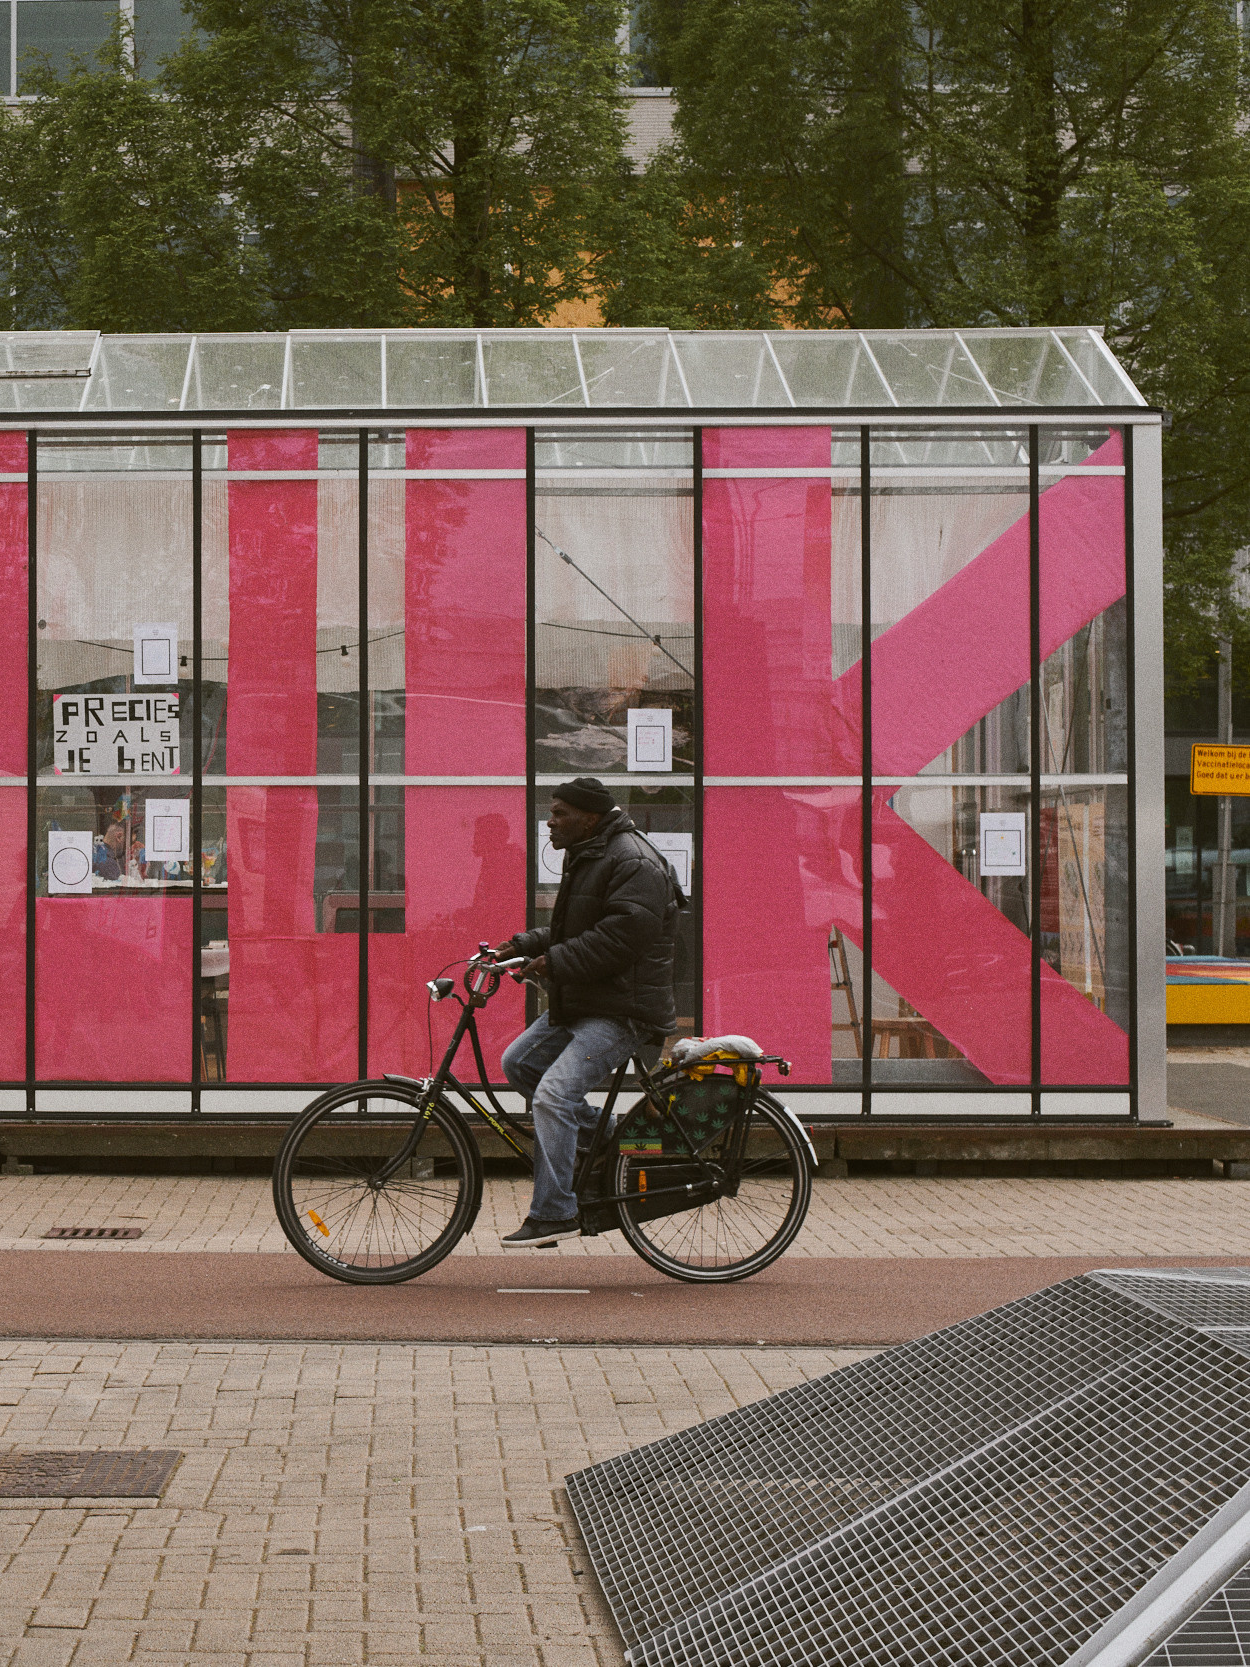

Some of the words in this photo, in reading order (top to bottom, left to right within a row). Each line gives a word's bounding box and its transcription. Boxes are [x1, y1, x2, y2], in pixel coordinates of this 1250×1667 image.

[62, 697, 180, 727] PRECIES
[56, 727, 171, 744] ZOALS
[61, 748, 91, 773] JE
[117, 746, 179, 773] bENT
[1197, 750, 1225, 758] Welkom
[1227, 750, 1237, 760] bij
[1196, 771, 1215, 779] Goed
[1215, 771, 1228, 779] dat
[423, 1102, 435, 1119] 1976
